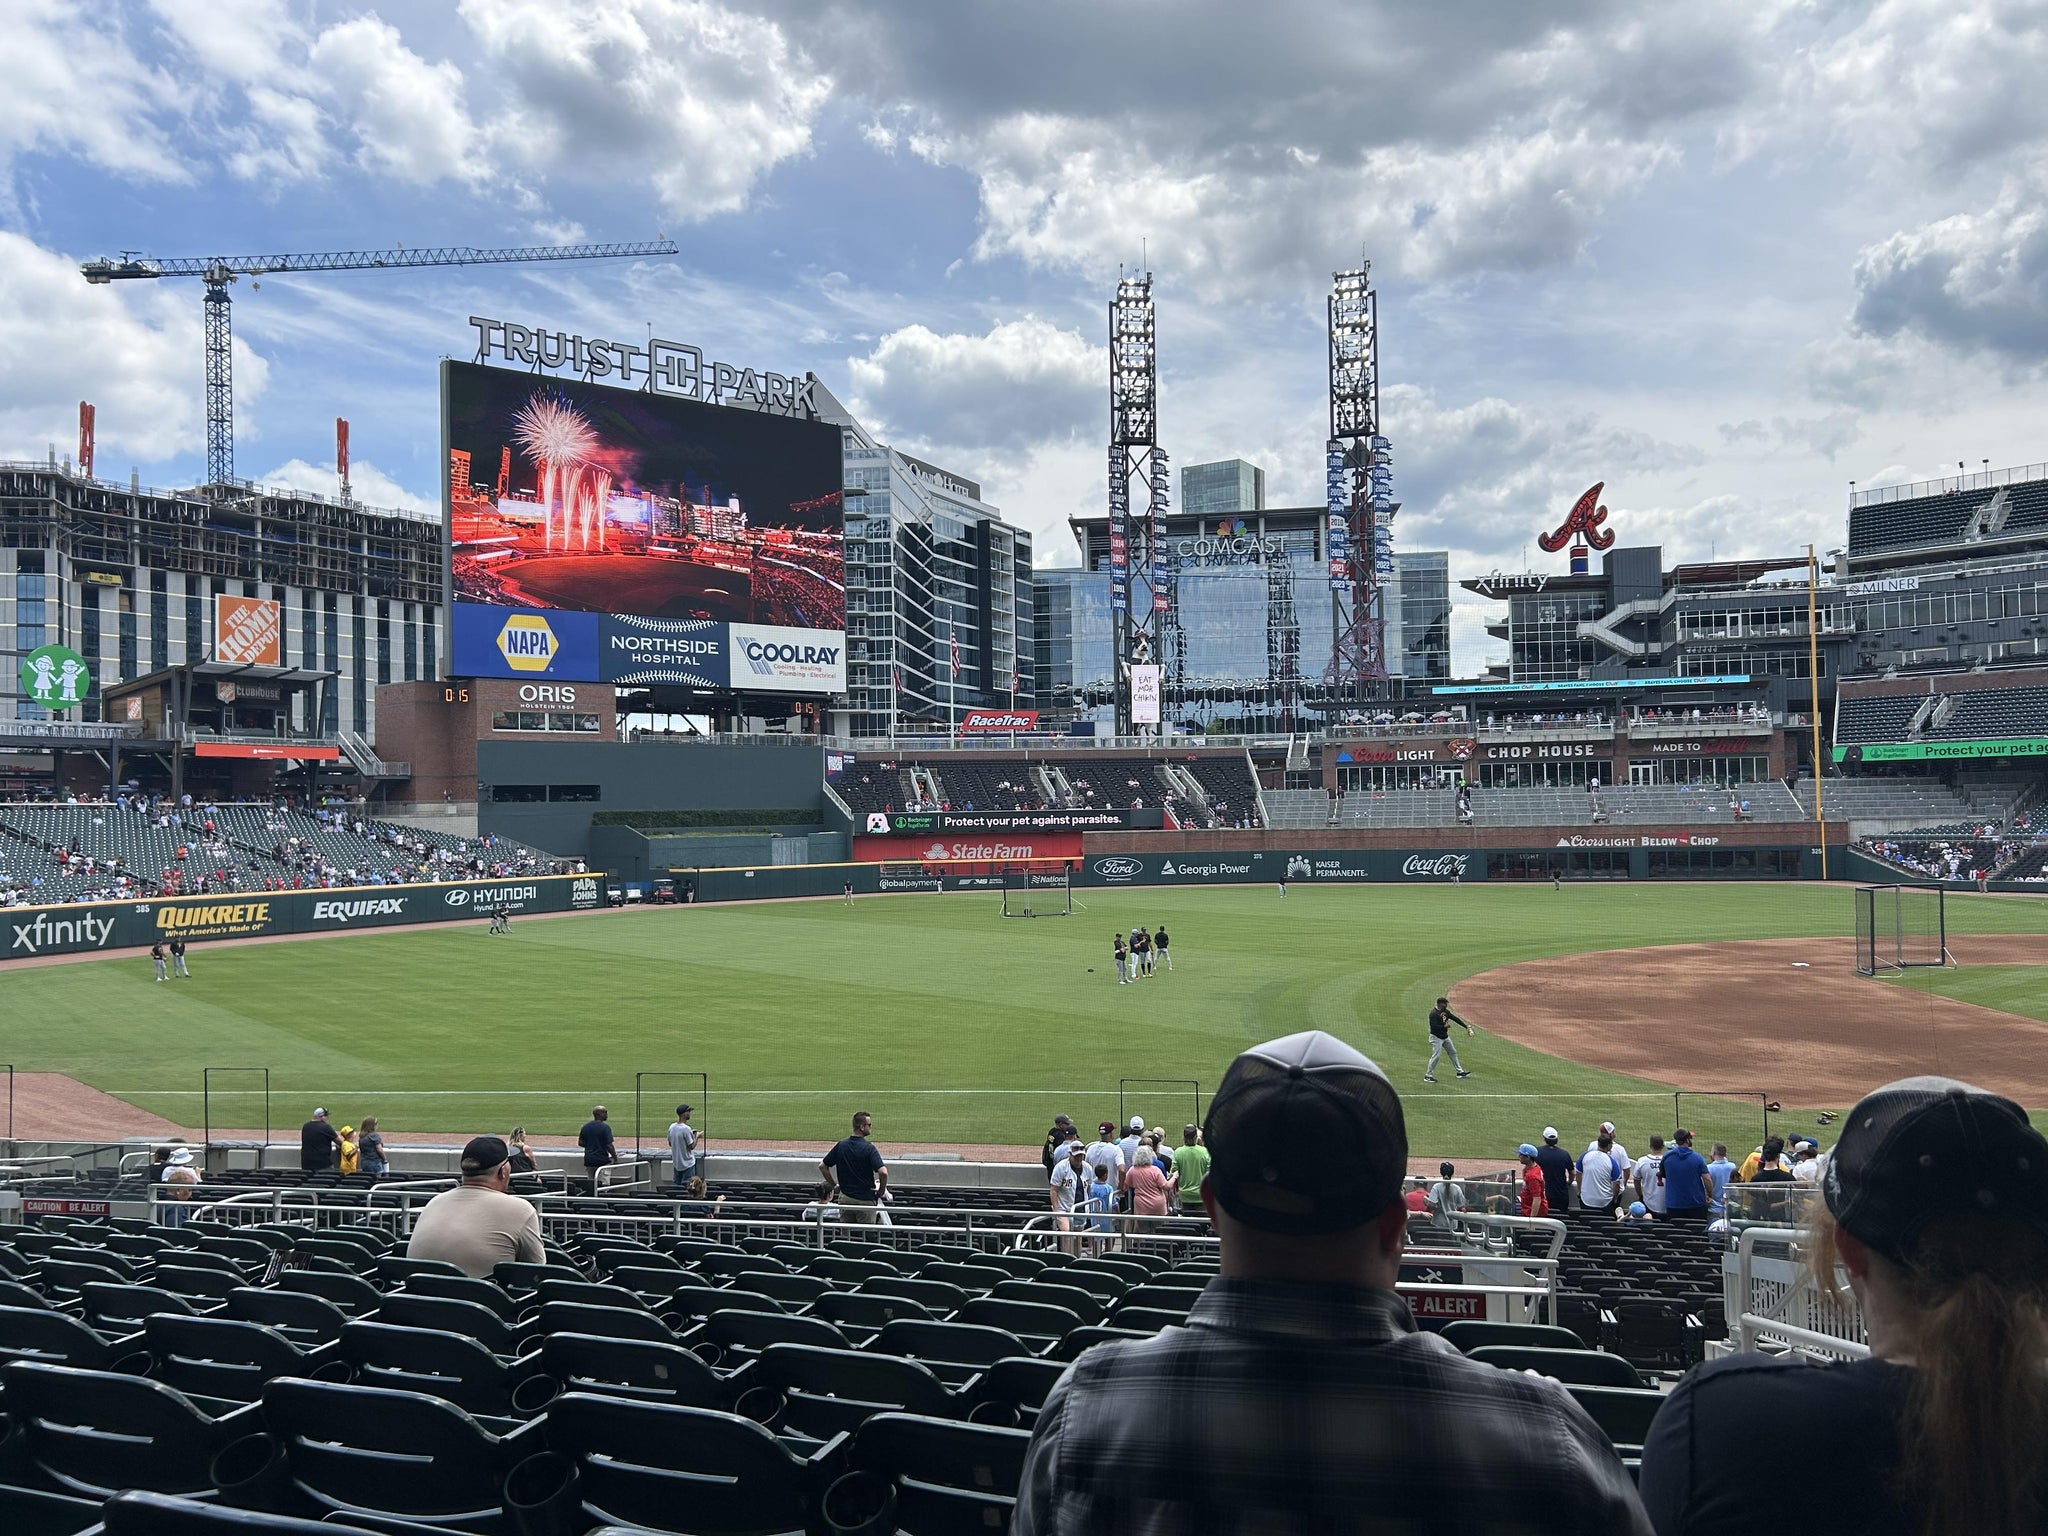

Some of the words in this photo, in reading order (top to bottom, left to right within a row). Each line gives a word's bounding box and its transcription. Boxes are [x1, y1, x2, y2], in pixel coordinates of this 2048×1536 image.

[469, 316, 640, 380] TRUIST
[713, 361, 818, 413] PARK
[1375, 469, 1388, 477] 2001
[1330, 488, 1344, 496] 2002
[1375, 484, 1389, 492] 2003
[1331, 518, 1343, 526] 2010
[1376, 515, 1389, 523] 2012
[1112, 539, 1124, 547] 1914
[1331, 533, 1344, 541] 2013
[1177, 535, 1288, 557] COMCAST
[1331, 548, 1345, 557] 2019
[1376, 545, 1390, 554] 2020
[1376, 561, 1390, 569] 2022
[1332, 580, 1345, 588] 2023
[1475, 569, 1550, 594] xfinity
[1863, 578, 1916, 594] MILNER
[225, 604, 250, 630] THE
[219, 601, 279, 661] HOME
[243, 624, 279, 663] DEPOT
[508, 631, 550, 656] NAPA
[611, 636, 719, 655] NORTHSIDE
[632, 653, 700, 666] HOSPITAL
[746, 642, 841, 665] COOLRAY
[773, 663, 796, 671] Cooling
[778, 670, 806, 678] Plumbing
[809, 672, 837, 680] Electrical
[1138, 676, 1153, 684] EAT
[236, 687, 280, 699] CLUBHOUSE
[519, 684, 576, 703] ORIS
[1138, 684, 1153, 693] MOR
[1133, 694, 1157, 702] CHIKIN
[968, 715, 1030, 726] RaceTrac
[1487, 747, 1532, 758] CHOP
[1538, 745, 1594, 756] HOUSE
[1653, 743, 1684, 752] MADE
[1686, 743, 1701, 752] TO
[1925, 745, 1974, 756] Protect
[1977, 745, 2007, 757] your
[2010, 743, 2033, 755] pet
[1353, 749, 1395, 762] Coors
[1397, 750, 1435, 761] LIGHT
[944, 817, 984, 827] Protect
[986, 818, 1009, 828] your
[1012, 817, 1030, 828] pet
[1031, 816, 1070, 827] against
[1072, 815, 1122, 827] parasites.
[1570, 834, 1604, 847] Coors
[1604, 838, 1636, 847] LIGHT
[1641, 836, 1677, 846] BELOW
[1690, 836, 1719, 846] CHOP
[1103, 860, 1135, 874] Ford
[1178, 863, 1218, 876] Georgia
[1220, 863, 1250, 874] Power
[1316, 869, 1365, 877] PERMANENTE
[573, 878, 597, 891] PAPA
[473, 886, 537, 903] HYUNDAI
[572, 890, 597, 901] JOHNS
[136, 905, 150, 914] 385
[156, 903, 270, 929] QUIKRETE
[313, 898, 404, 922] EQUIFAX
[12, 912, 115, 952] xfinity
[165, 929, 182, 937] What
[184, 926, 227, 937] America's
[229, 925, 249, 933] Made
[27, 1201, 62, 1212] CAUTION
[69, 1202, 80, 1212] BE
[81, 1202, 105, 1212] ALERT
[1423, 1296, 1478, 1314] ALERT
